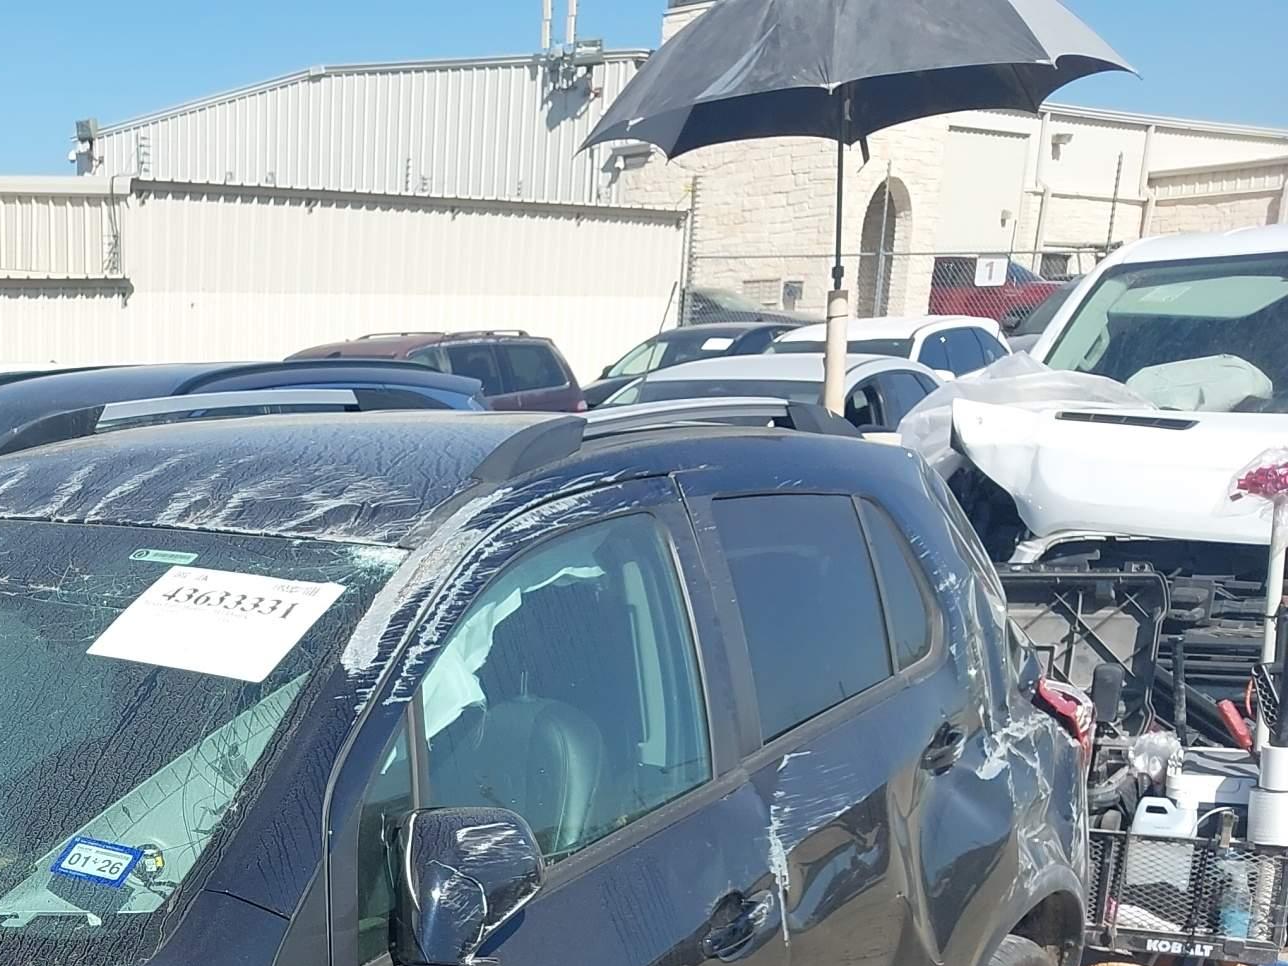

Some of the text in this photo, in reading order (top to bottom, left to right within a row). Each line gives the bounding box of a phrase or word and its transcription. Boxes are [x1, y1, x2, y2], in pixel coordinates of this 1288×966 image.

[985, 260, 995, 281] 1
[162, 585, 300, 619] 43633331
[68, 852, 91, 868] 01
[96, 858, 124, 875] 26
